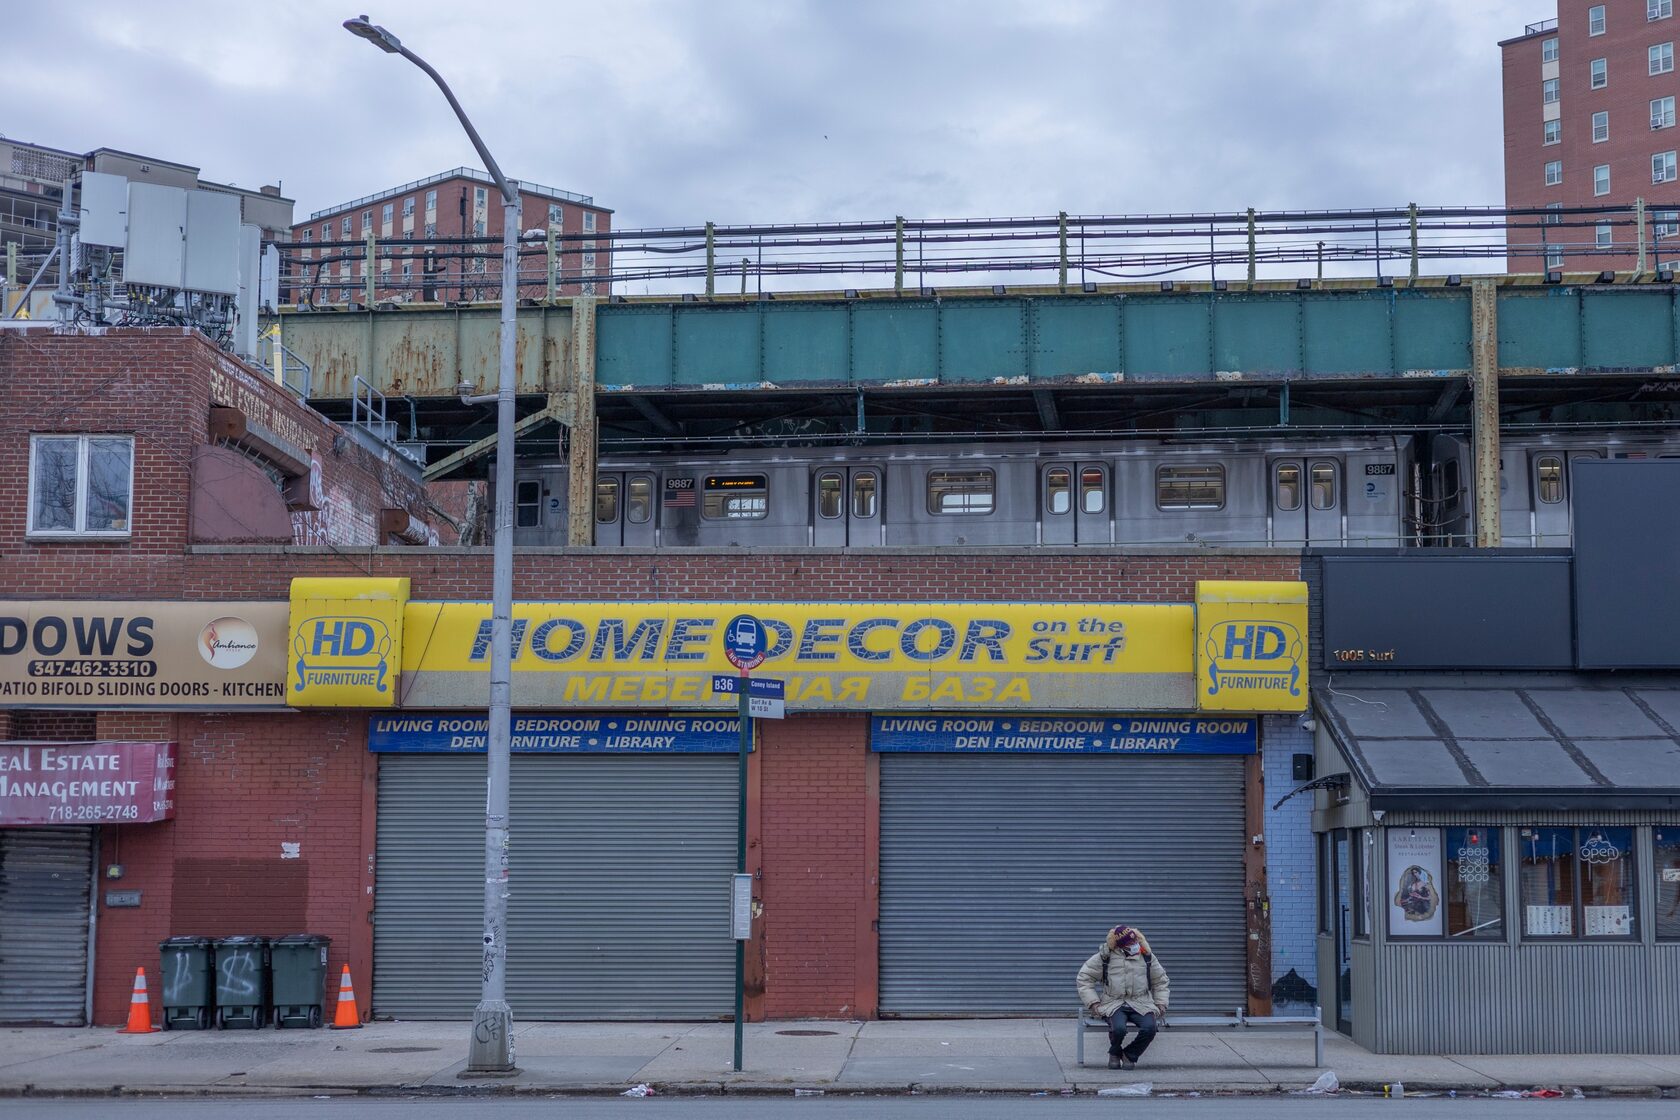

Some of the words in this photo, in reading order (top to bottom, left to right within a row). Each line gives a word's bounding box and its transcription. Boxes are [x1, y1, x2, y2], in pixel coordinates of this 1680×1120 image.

[1367, 465, 1393, 475] 9887
[668, 480, 693, 489] 9887
[1032, 621, 1067, 632] on
[1078, 618, 1123, 632] the
[0, 616, 154, 656] DOWS
[312, 621, 375, 656] HD
[469, 618, 717, 662] HOME
[1223, 625, 1286, 659] HD
[213, 640, 256, 649] Ambiance
[1026, 637, 1124, 661] Surf
[728, 652, 737, 662] NO
[737, 654, 764, 669] STANDING
[1333, 649, 1364, 661] 1005
[1368, 648, 1394, 661] Surf
[34, 661, 151, 676] 347-462-3310
[307, 672, 376, 686] FURNITURE
[714, 678, 734, 691] B36
[1220, 676, 1288, 690] FURNITURE
[0, 681, 37, 695] ATIO
[41, 682, 93, 696] BIFOLD
[97, 682, 156, 696] SLIDING
[160, 682, 210, 696] DOORS
[222, 682, 284, 696] KITCHEN
[902, 676, 1031, 702] БАЗА
[376, 720, 433, 733] LIVING
[437, 719, 489, 732] ROOM
[515, 719, 600, 732] BEDROOM
[624, 720, 686, 732] DINING
[690, 720, 741, 732] ROOM
[880, 720, 937, 732] LIVING
[942, 720, 994, 732] ROOM
[1019, 721, 1104, 733] BEDROOM
[1129, 721, 1191, 734] DINING
[1195, 721, 1248, 734] ROOM
[451, 736, 486, 748] DEN
[510, 736, 580, 748] RNITURE
[605, 736, 676, 748] LIBRARY
[955, 736, 989, 748] DEN
[994, 736, 1085, 749] FURNITURE
[1110, 737, 1180, 750] LIBRARY
[41, 748, 120, 771] ESTATE
[49, 804, 138, 820] 718-265-2748
[1458, 848, 1489, 856] GOOD
[1581, 848, 1615, 858] open
[1458, 866, 1489, 874] GOOD
[1459, 874, 1489, 882] MOOD
